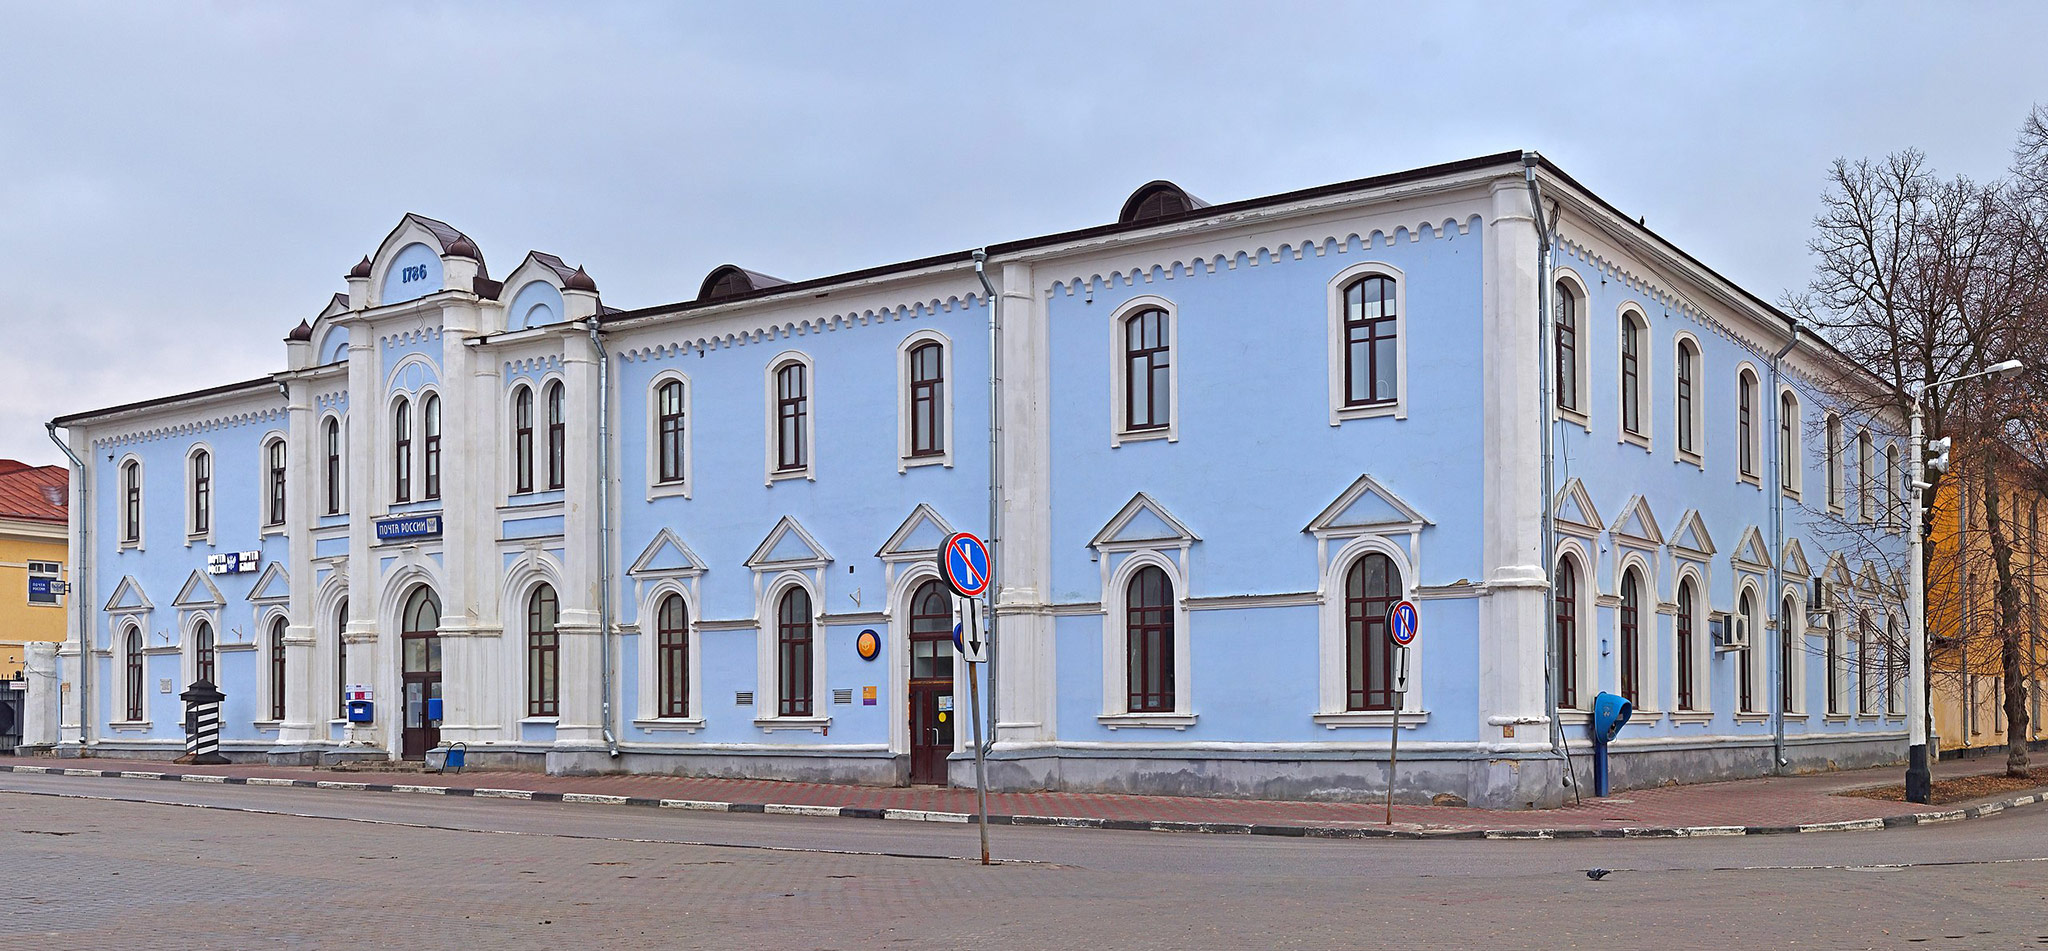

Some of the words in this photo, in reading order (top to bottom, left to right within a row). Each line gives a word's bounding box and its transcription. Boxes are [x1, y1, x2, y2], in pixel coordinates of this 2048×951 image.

[402, 264, 427, 283] 1786
[379, 523, 399, 535] ПОЧТА
[401, 521, 426, 533] РОССИИ
